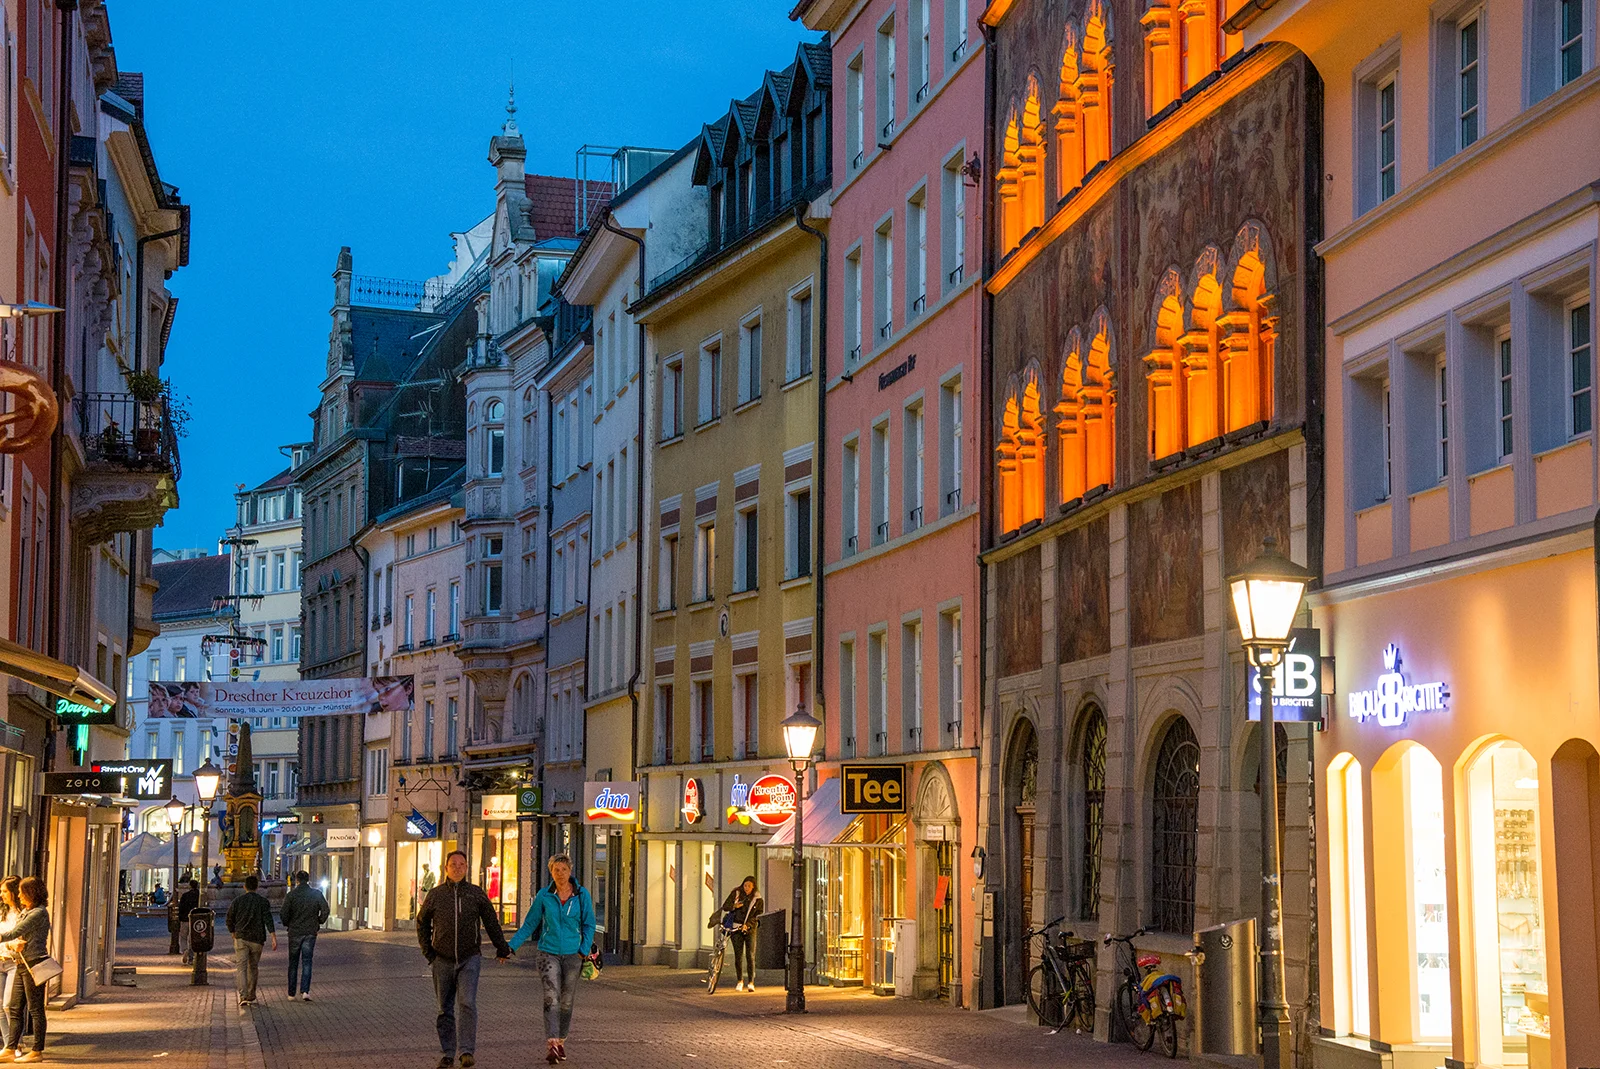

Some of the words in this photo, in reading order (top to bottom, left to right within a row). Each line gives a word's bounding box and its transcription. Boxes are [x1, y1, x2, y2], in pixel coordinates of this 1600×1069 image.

[214, 688, 278, 702] Dresdner
[282, 686, 353, 701] Kreuzchor
[214, 706, 247, 714] Sonntag,
[323, 703, 352, 711] Münster
[1279, 697, 1314, 707] BRIGITTE
[66, 779, 101, 788] zero
[754, 783, 789, 796] Kreativ
[847, 773, 901, 804] Tee
[594, 787, 630, 809] dm
[770, 792, 795, 803] Point
[411, 816, 434, 837] Mimi
